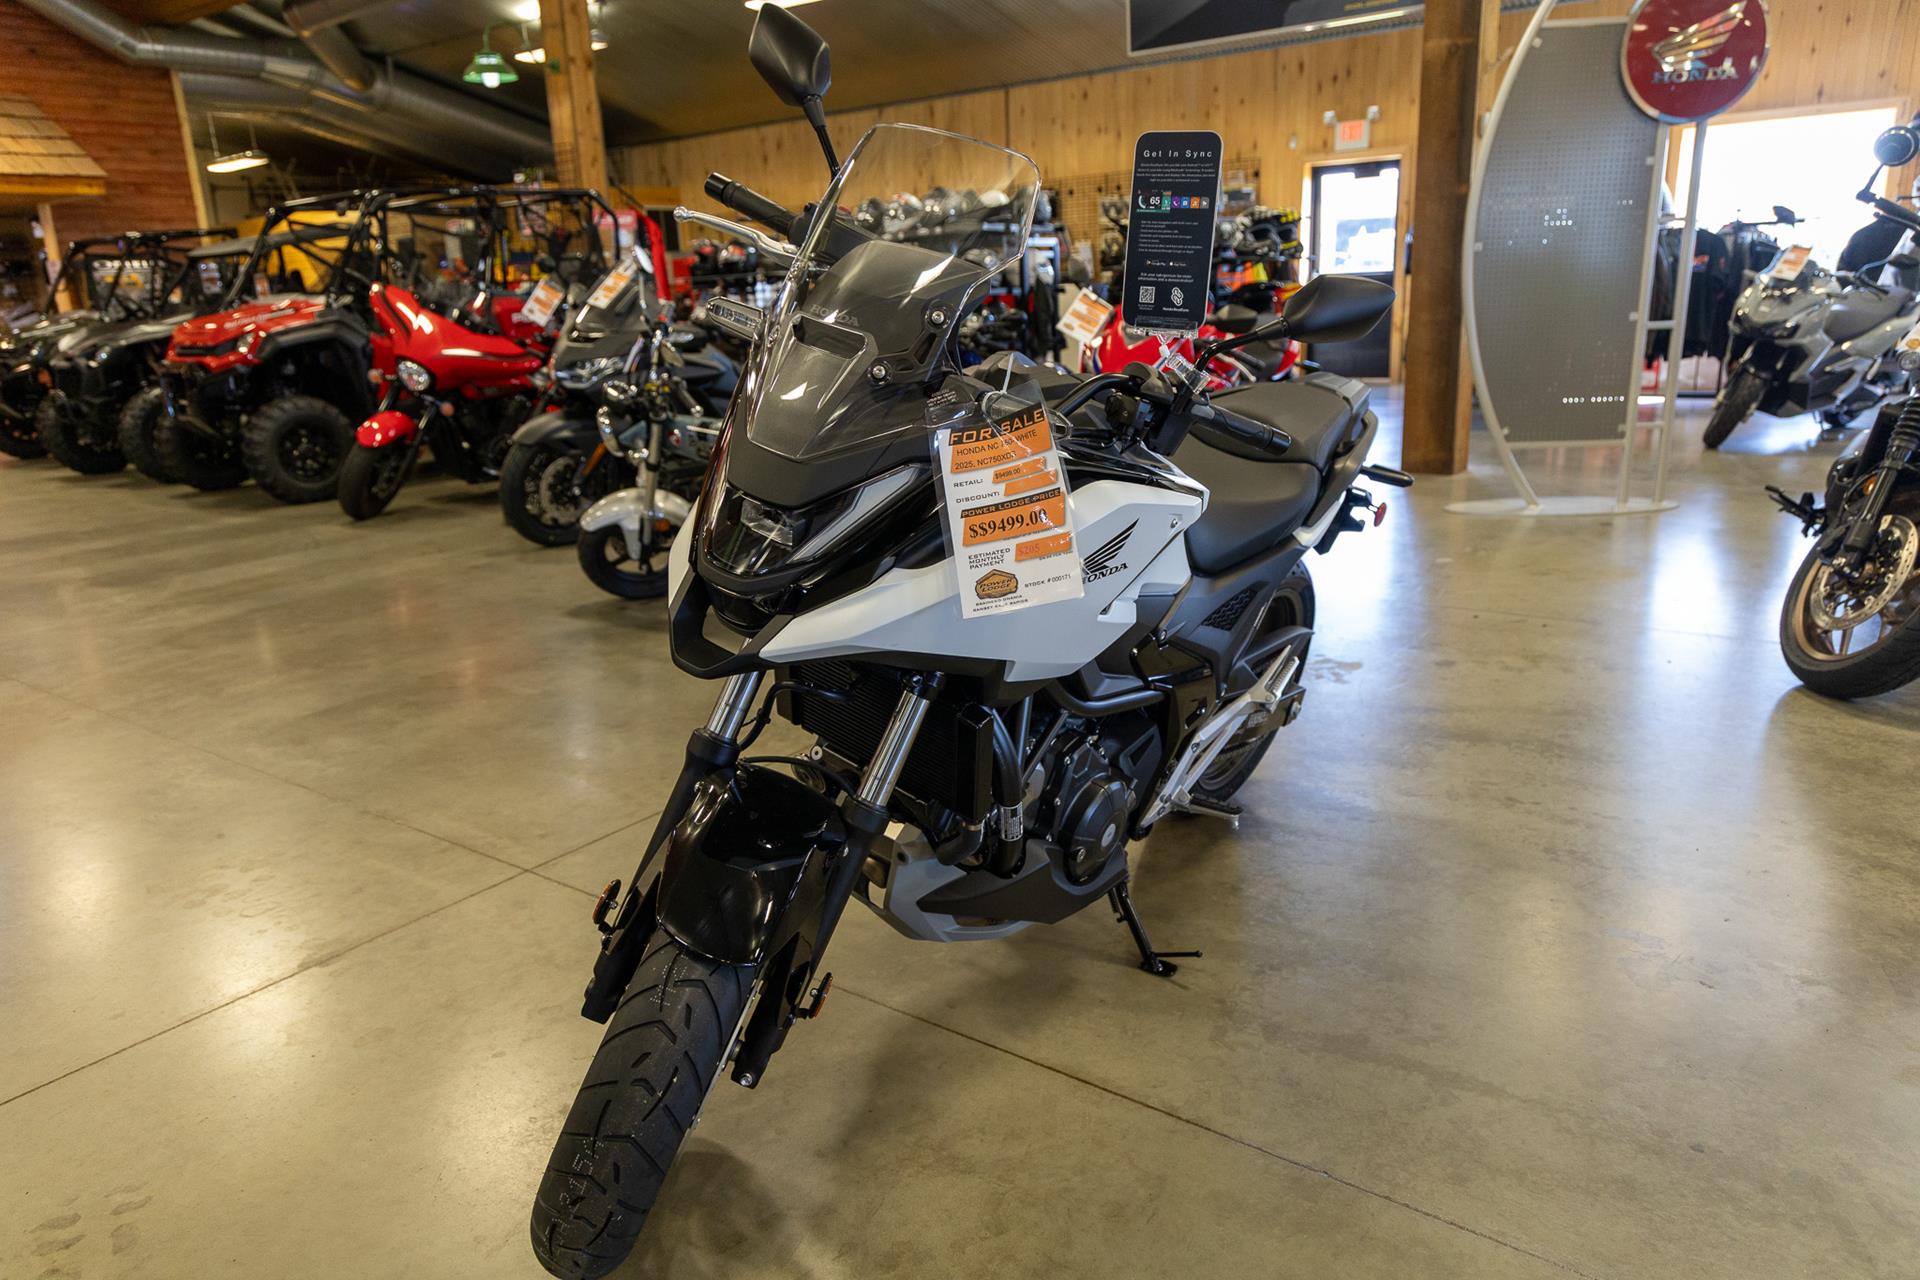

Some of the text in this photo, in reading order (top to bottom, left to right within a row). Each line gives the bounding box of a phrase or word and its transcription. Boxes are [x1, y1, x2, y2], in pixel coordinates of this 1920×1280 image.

[1651, 66, 1738, 84] HONDA
[1143, 149, 1213, 159] Get In Sync
[1149, 196, 1161, 205] 65
[810, 303, 860, 328] HODA
[949, 408, 1045, 446] FOR SALE
[956, 445, 986, 457] HONDA
[988, 442, 999, 451] NC
[953, 478, 983, 488] RETAIL:
[962, 488, 1061, 517] POWER LODGE PRICE
[968, 547, 1011, 560] ESTIMATED
[969, 554, 1004, 565] MONTHLY
[970, 559, 1004, 570] PAYMENT
[980, 578, 1012, 589] POWER
[982, 582, 1011, 593] LODGE
[1024, 580, 1045, 588] STOCK
